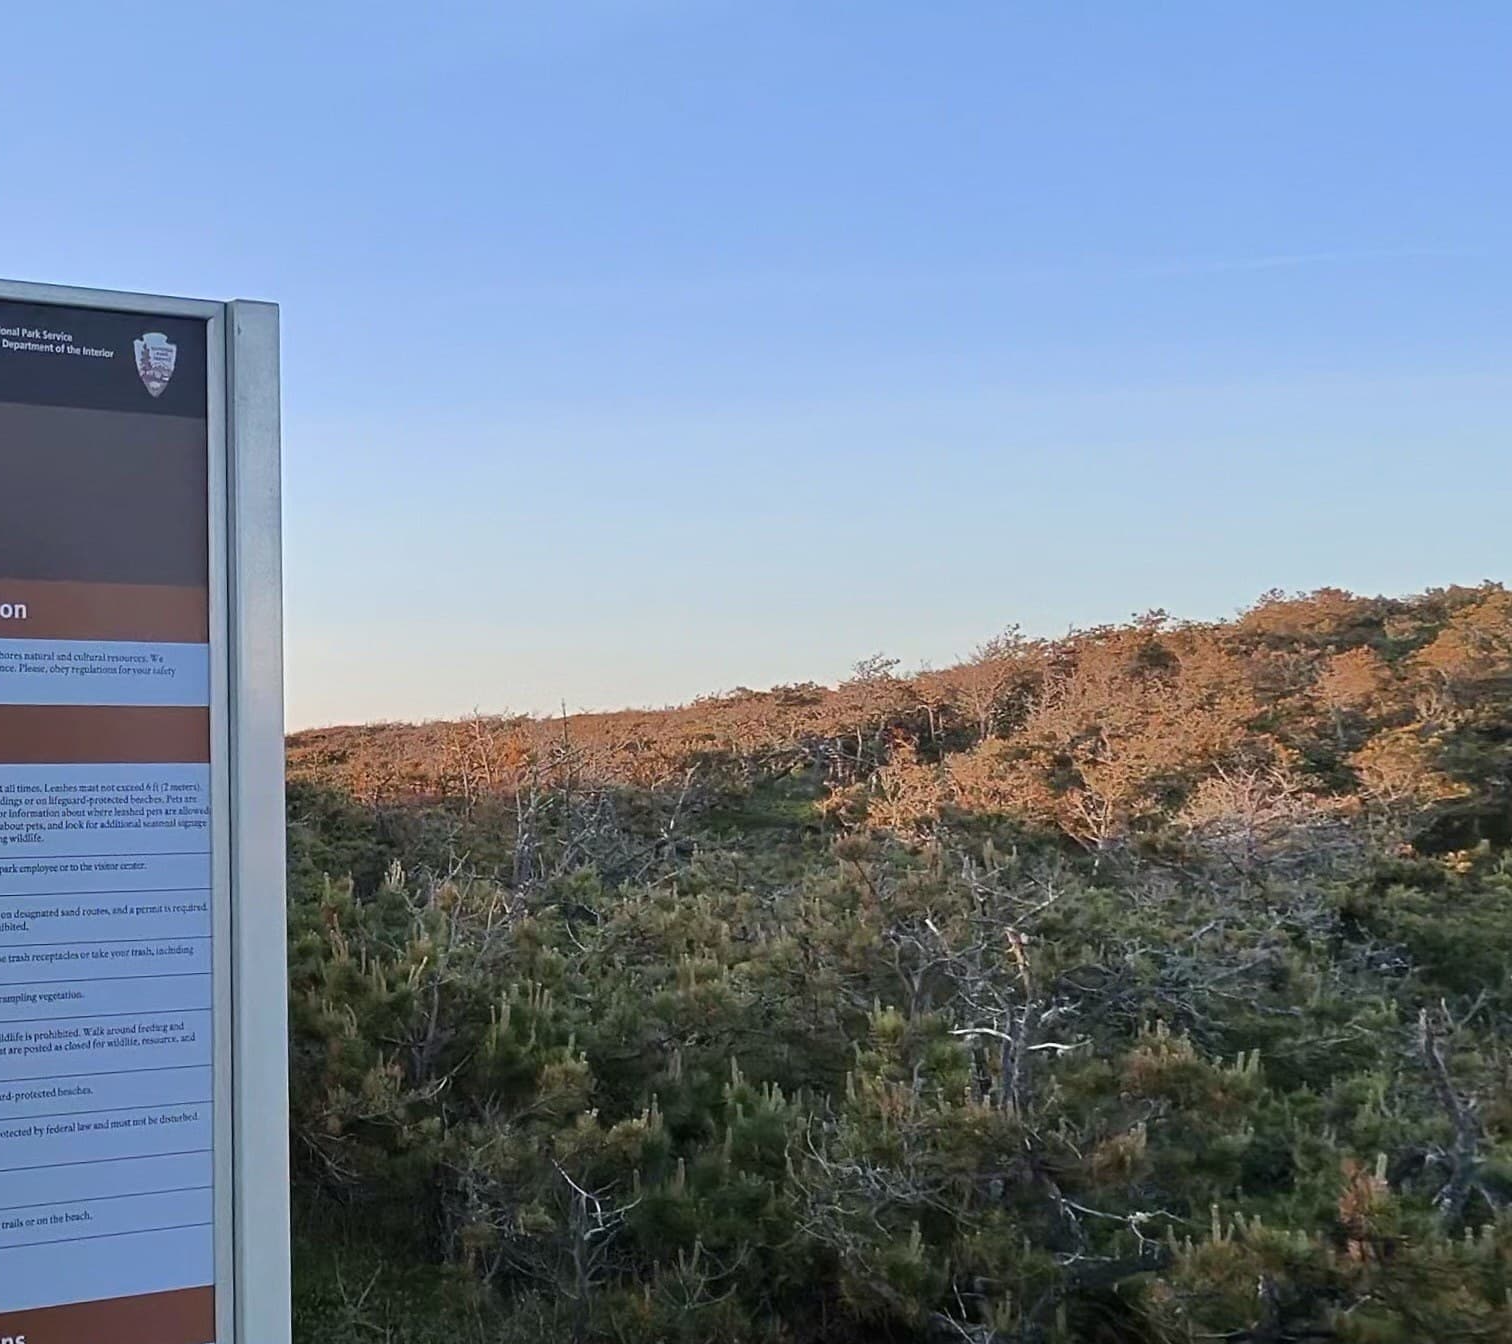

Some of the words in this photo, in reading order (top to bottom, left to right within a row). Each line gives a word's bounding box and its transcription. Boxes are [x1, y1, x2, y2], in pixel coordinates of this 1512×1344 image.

[21, 328, 40, 338] Park
[42, 330, 72, 341] Service
[2, 338, 53, 352] Department
[55, 343, 64, 352] of
[66, 345, 80, 354] the
[82, 346, 114, 357] Interior
[38, 991, 82, 1002] vegetation.
[57, 1086, 93, 1096] beaches.
